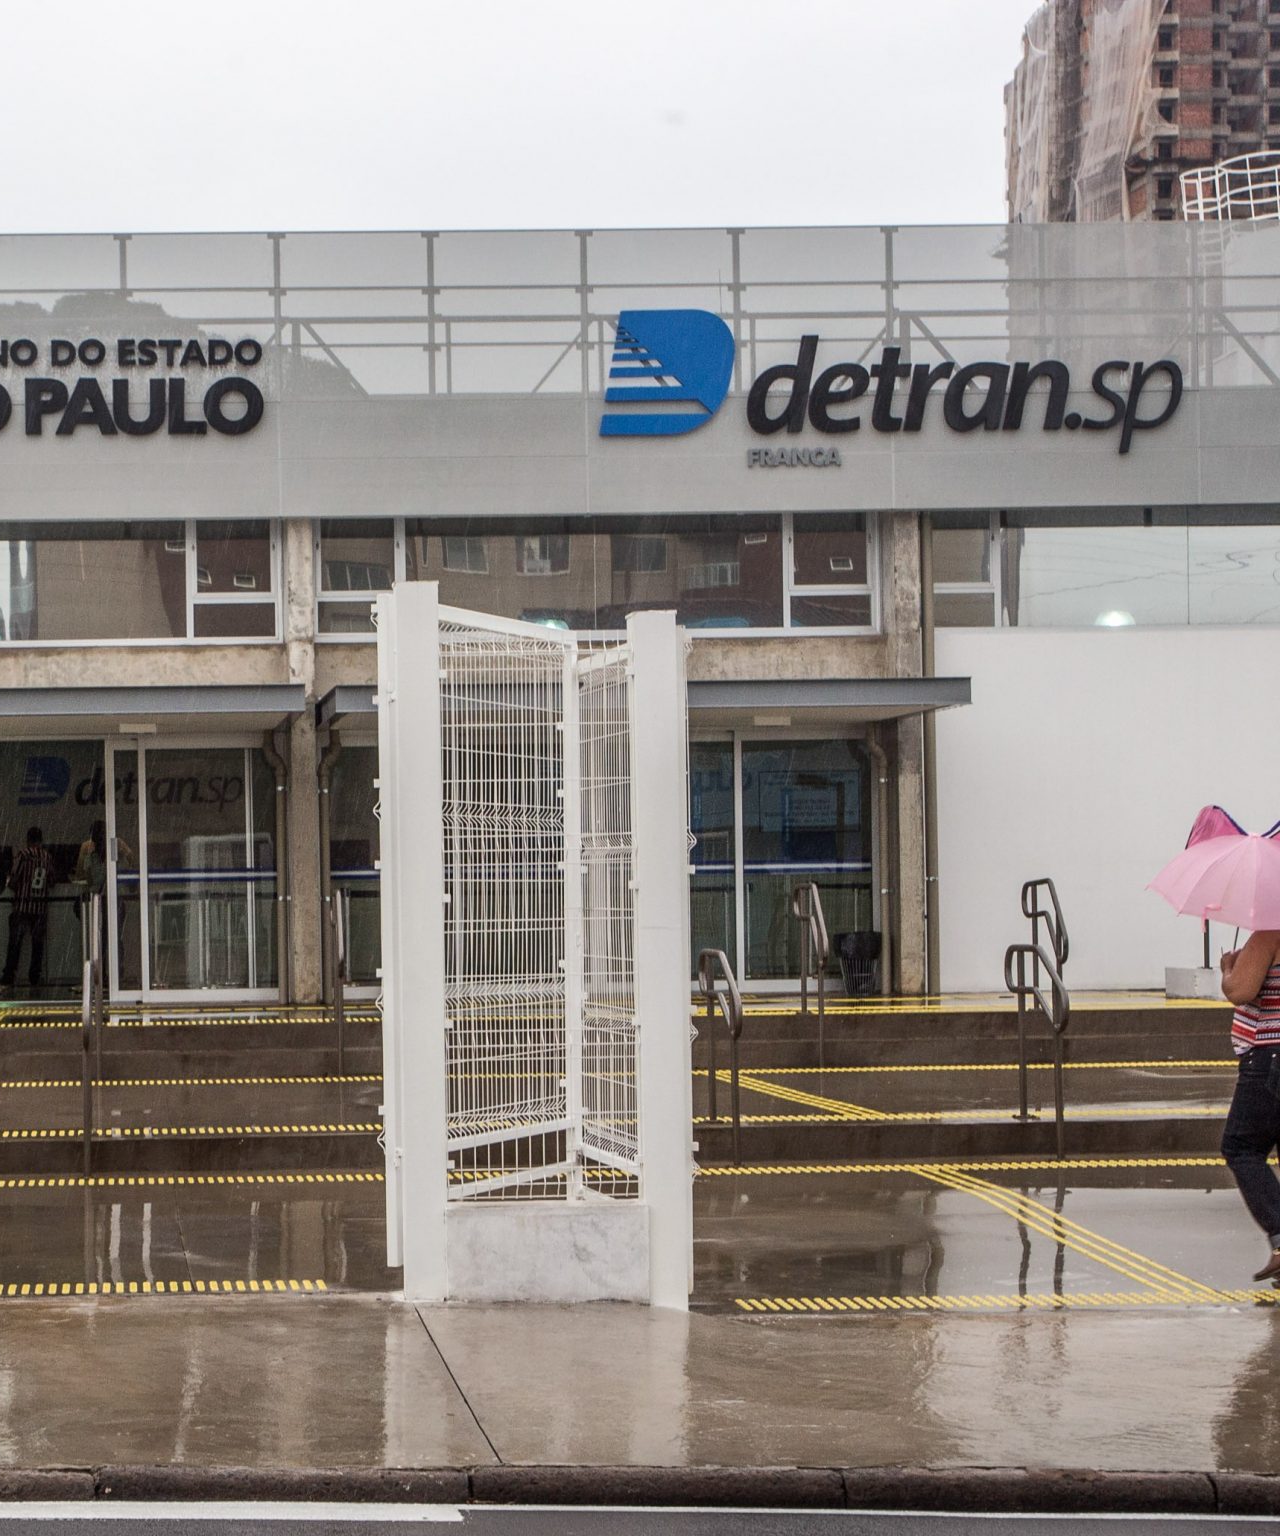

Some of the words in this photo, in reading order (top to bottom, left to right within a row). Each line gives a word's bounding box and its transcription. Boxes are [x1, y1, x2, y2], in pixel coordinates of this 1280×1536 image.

[51, 340, 106, 368] DO
[117, 339, 263, 368] ESTADO
[25, 377, 265, 437] PAULO
[747, 335, 1184, 455] detran.sp
[747, 446, 841, 468] FRANCA
